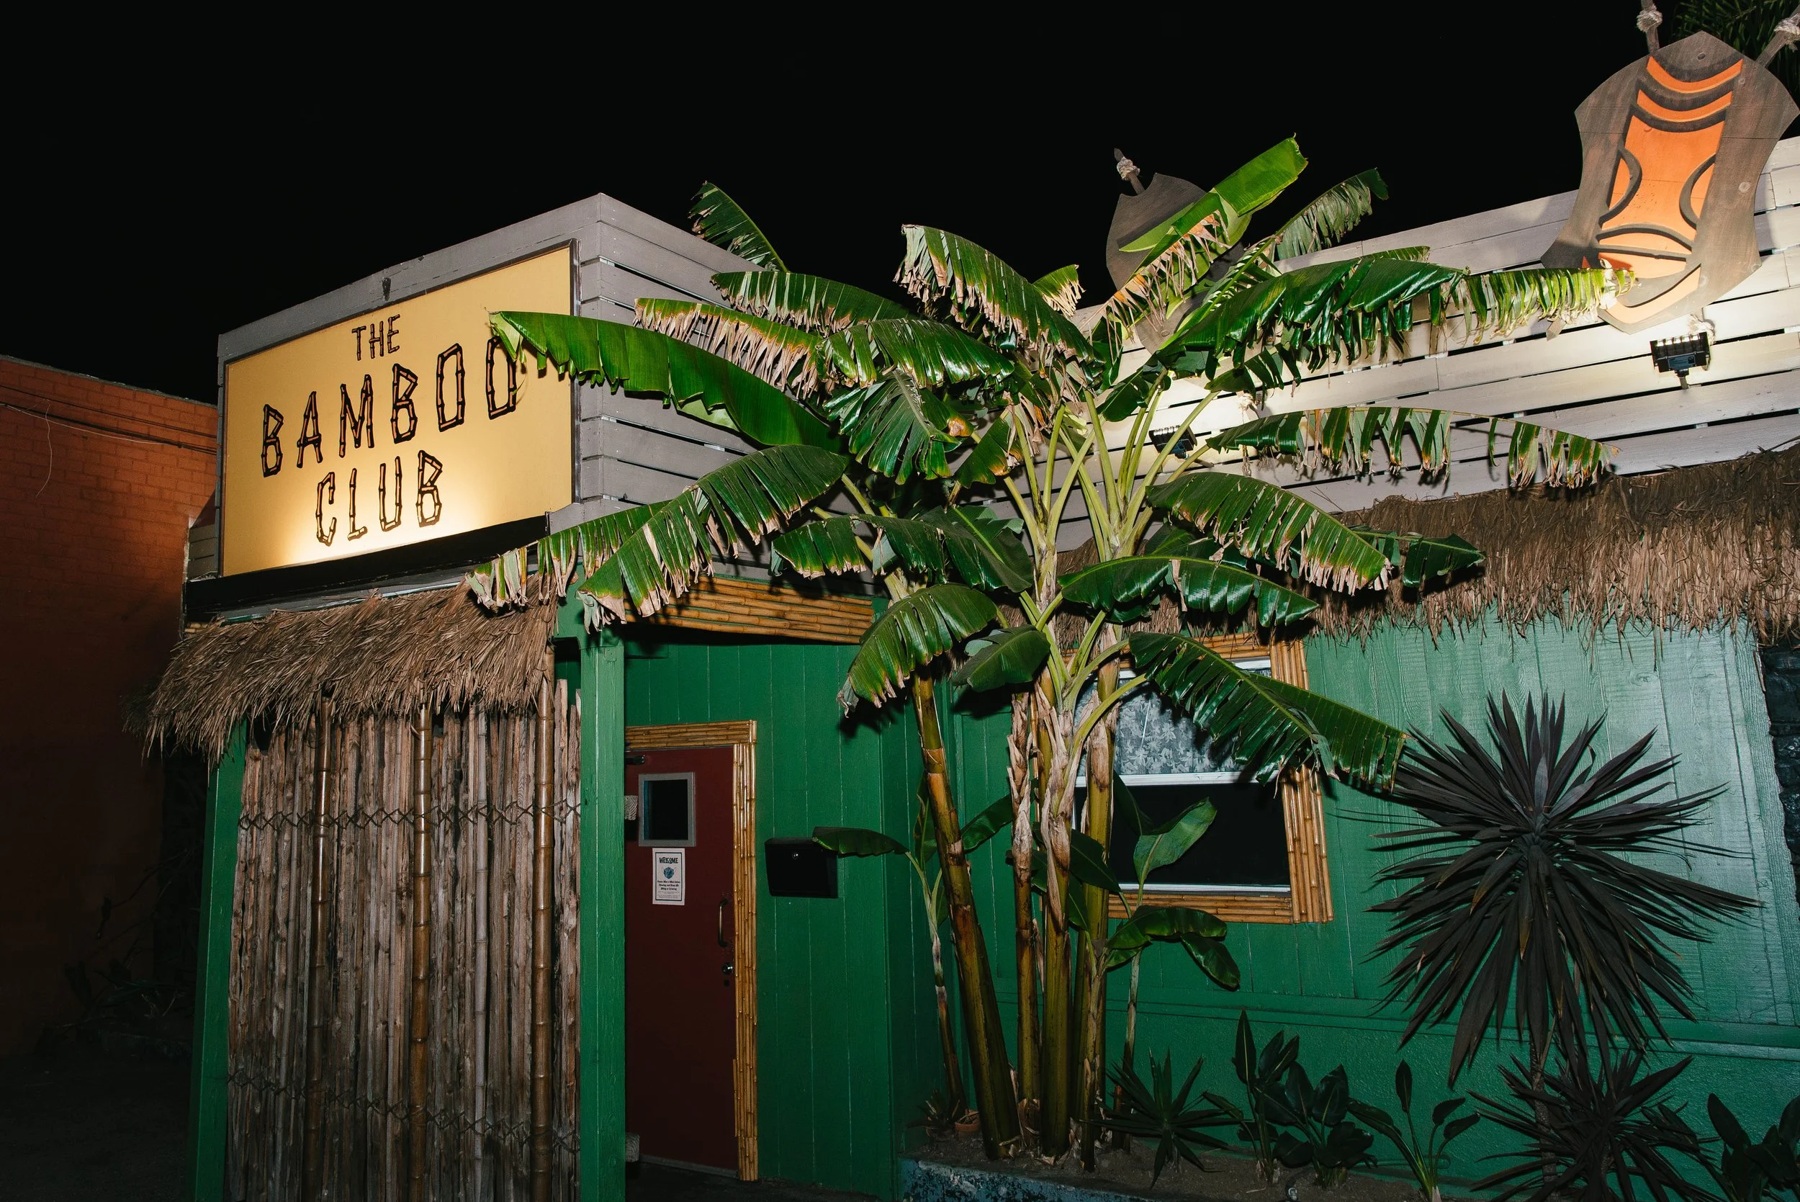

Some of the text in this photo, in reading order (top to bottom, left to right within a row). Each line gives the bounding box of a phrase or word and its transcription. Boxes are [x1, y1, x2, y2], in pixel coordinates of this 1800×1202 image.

[352, 314, 400, 361] THE
[261, 336, 517, 477] BAMBOO
[315, 450, 443, 546] CLUB
